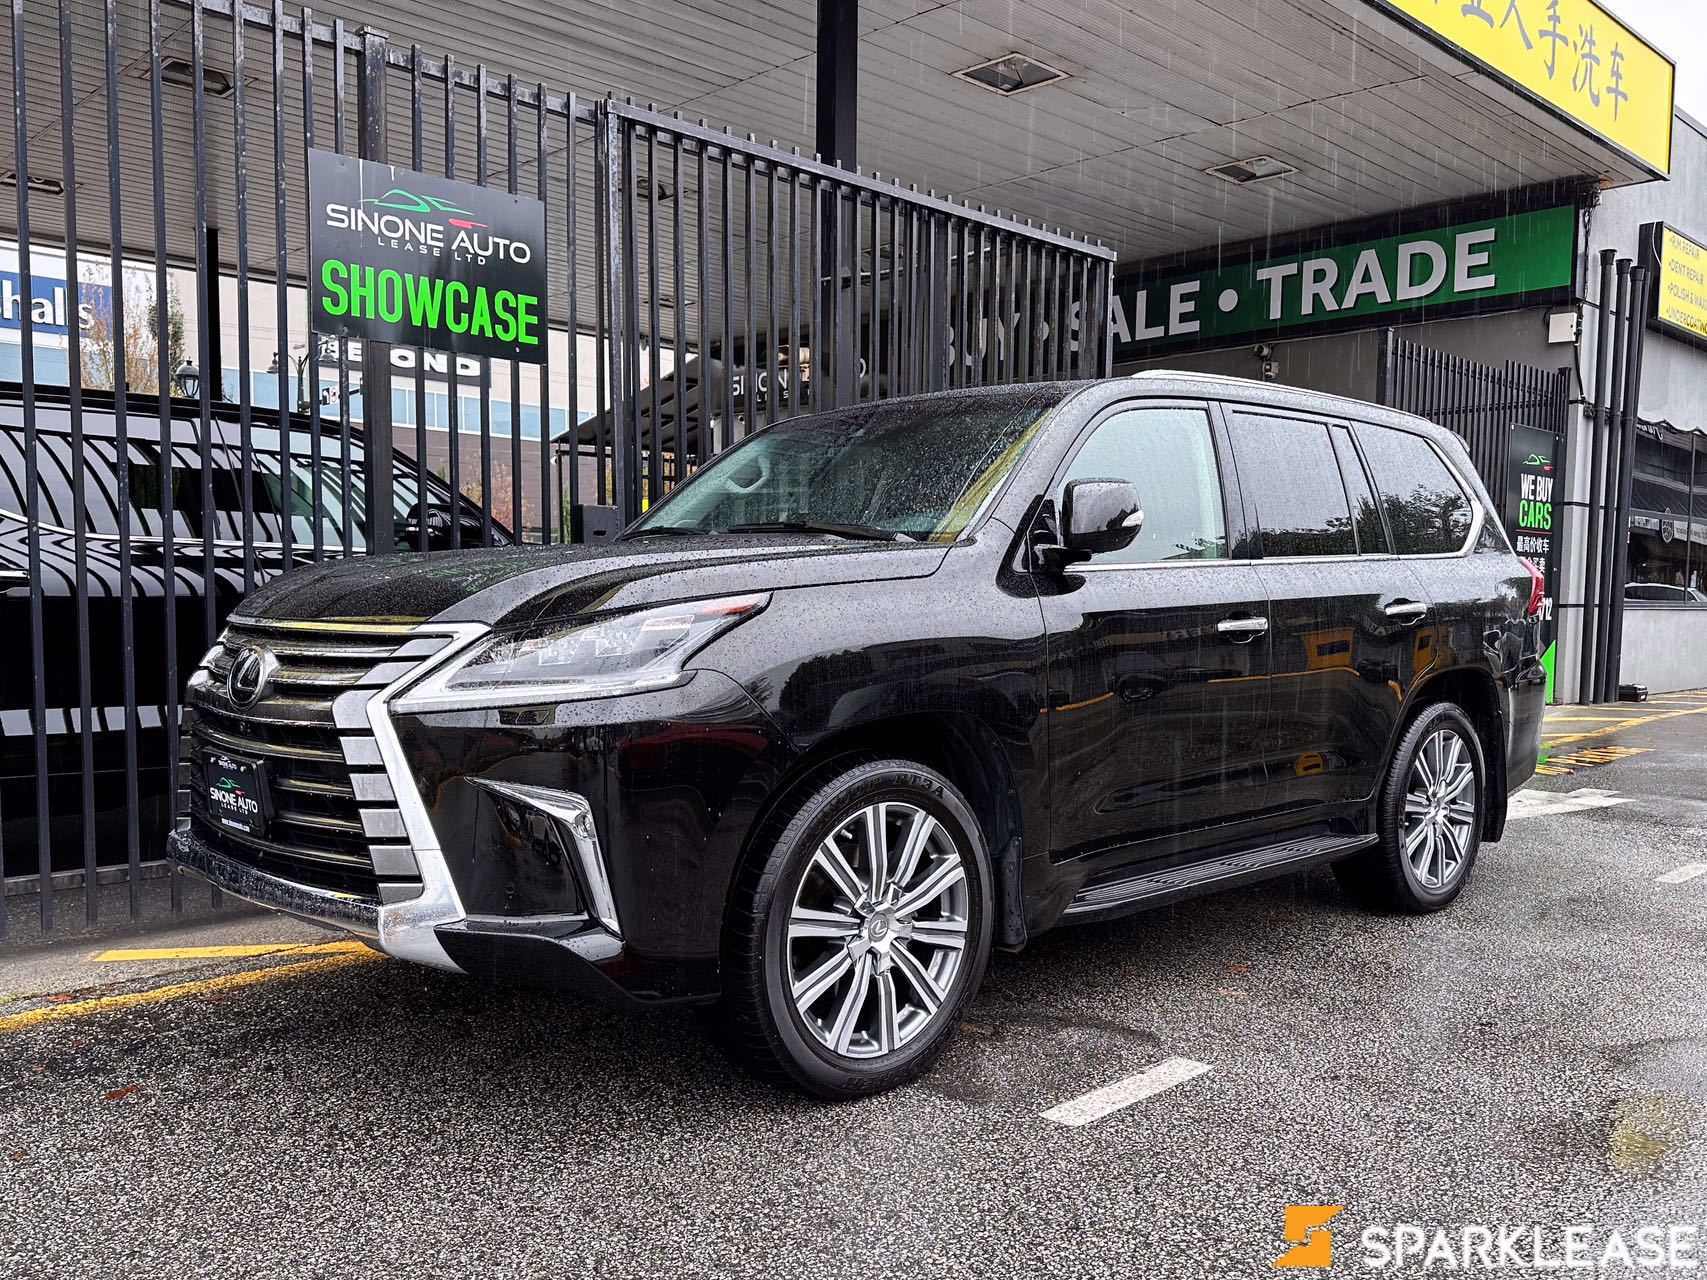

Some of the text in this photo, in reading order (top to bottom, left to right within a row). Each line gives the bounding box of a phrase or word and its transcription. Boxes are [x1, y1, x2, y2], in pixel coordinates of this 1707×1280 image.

[326, 203, 531, 264] SINONE AUTO
[378, 236, 486, 265] LEASE LTD
[1256, 227, 1496, 320] TRADE
[1, 279, 96, 330] hals
[321, 259, 539, 345] SHOWCASE
[1520, 473, 1553, 502] WE BUY
[1519, 499, 1552, 530] CARS
[237, 797, 258, 813] AUTO
